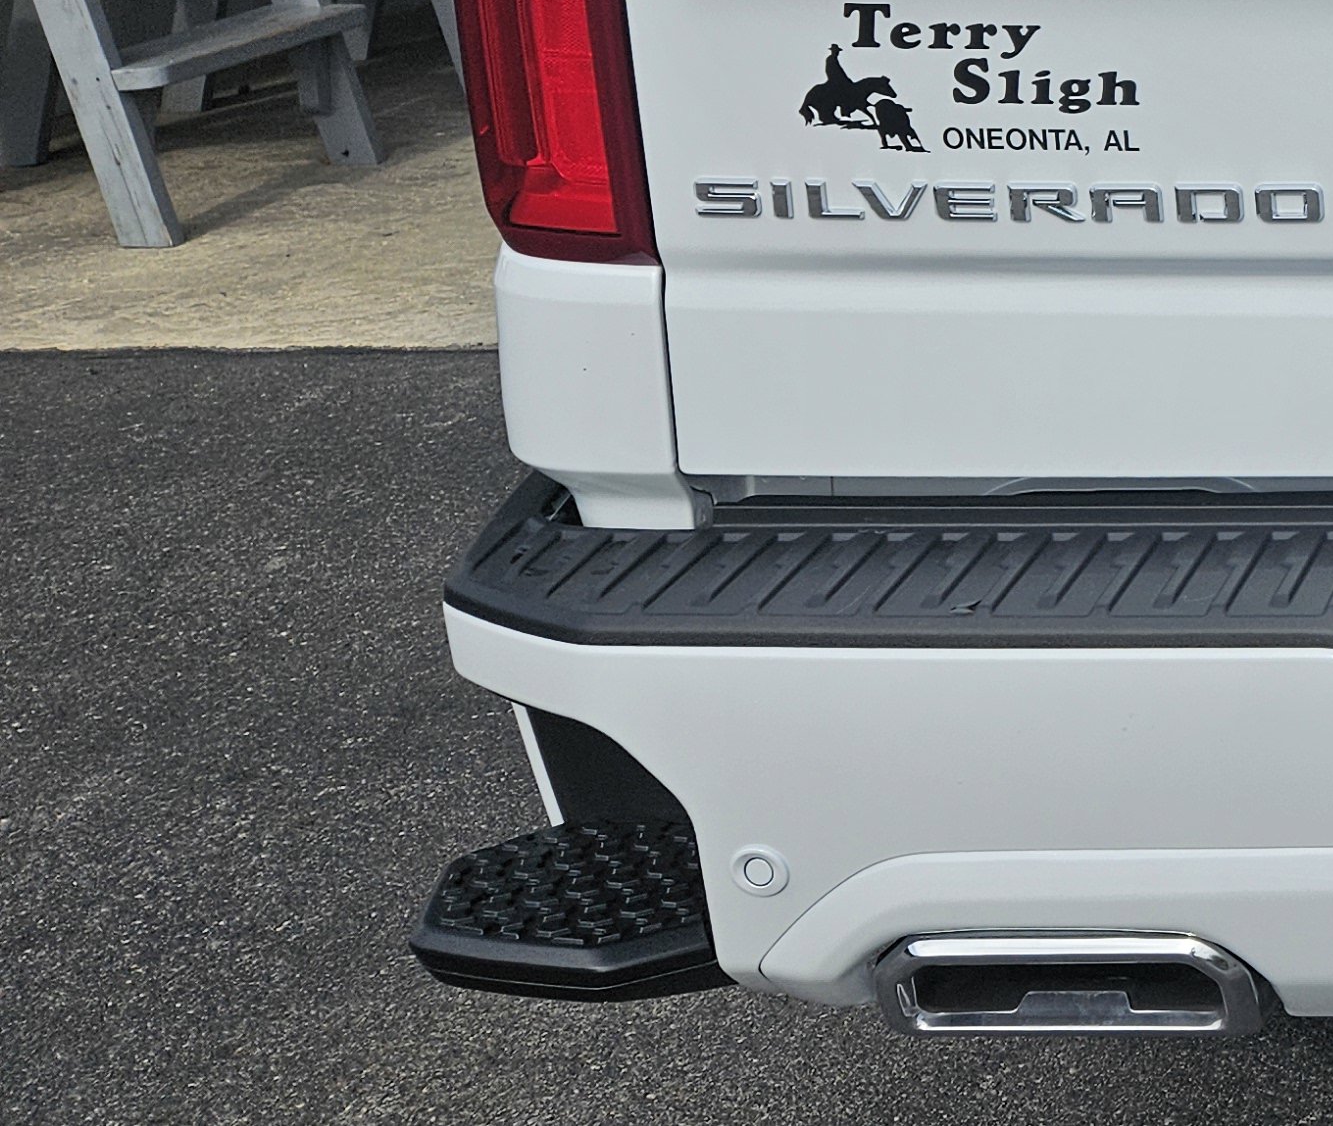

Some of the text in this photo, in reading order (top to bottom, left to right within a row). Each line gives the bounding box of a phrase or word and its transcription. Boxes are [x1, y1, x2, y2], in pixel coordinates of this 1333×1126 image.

[844, 3, 1041, 59] Terry
[952, 58, 1140, 114] Sligh
[943, 127, 1140, 156] ONEONTA, AL
[695, 178, 1325, 224] SILVERADO
